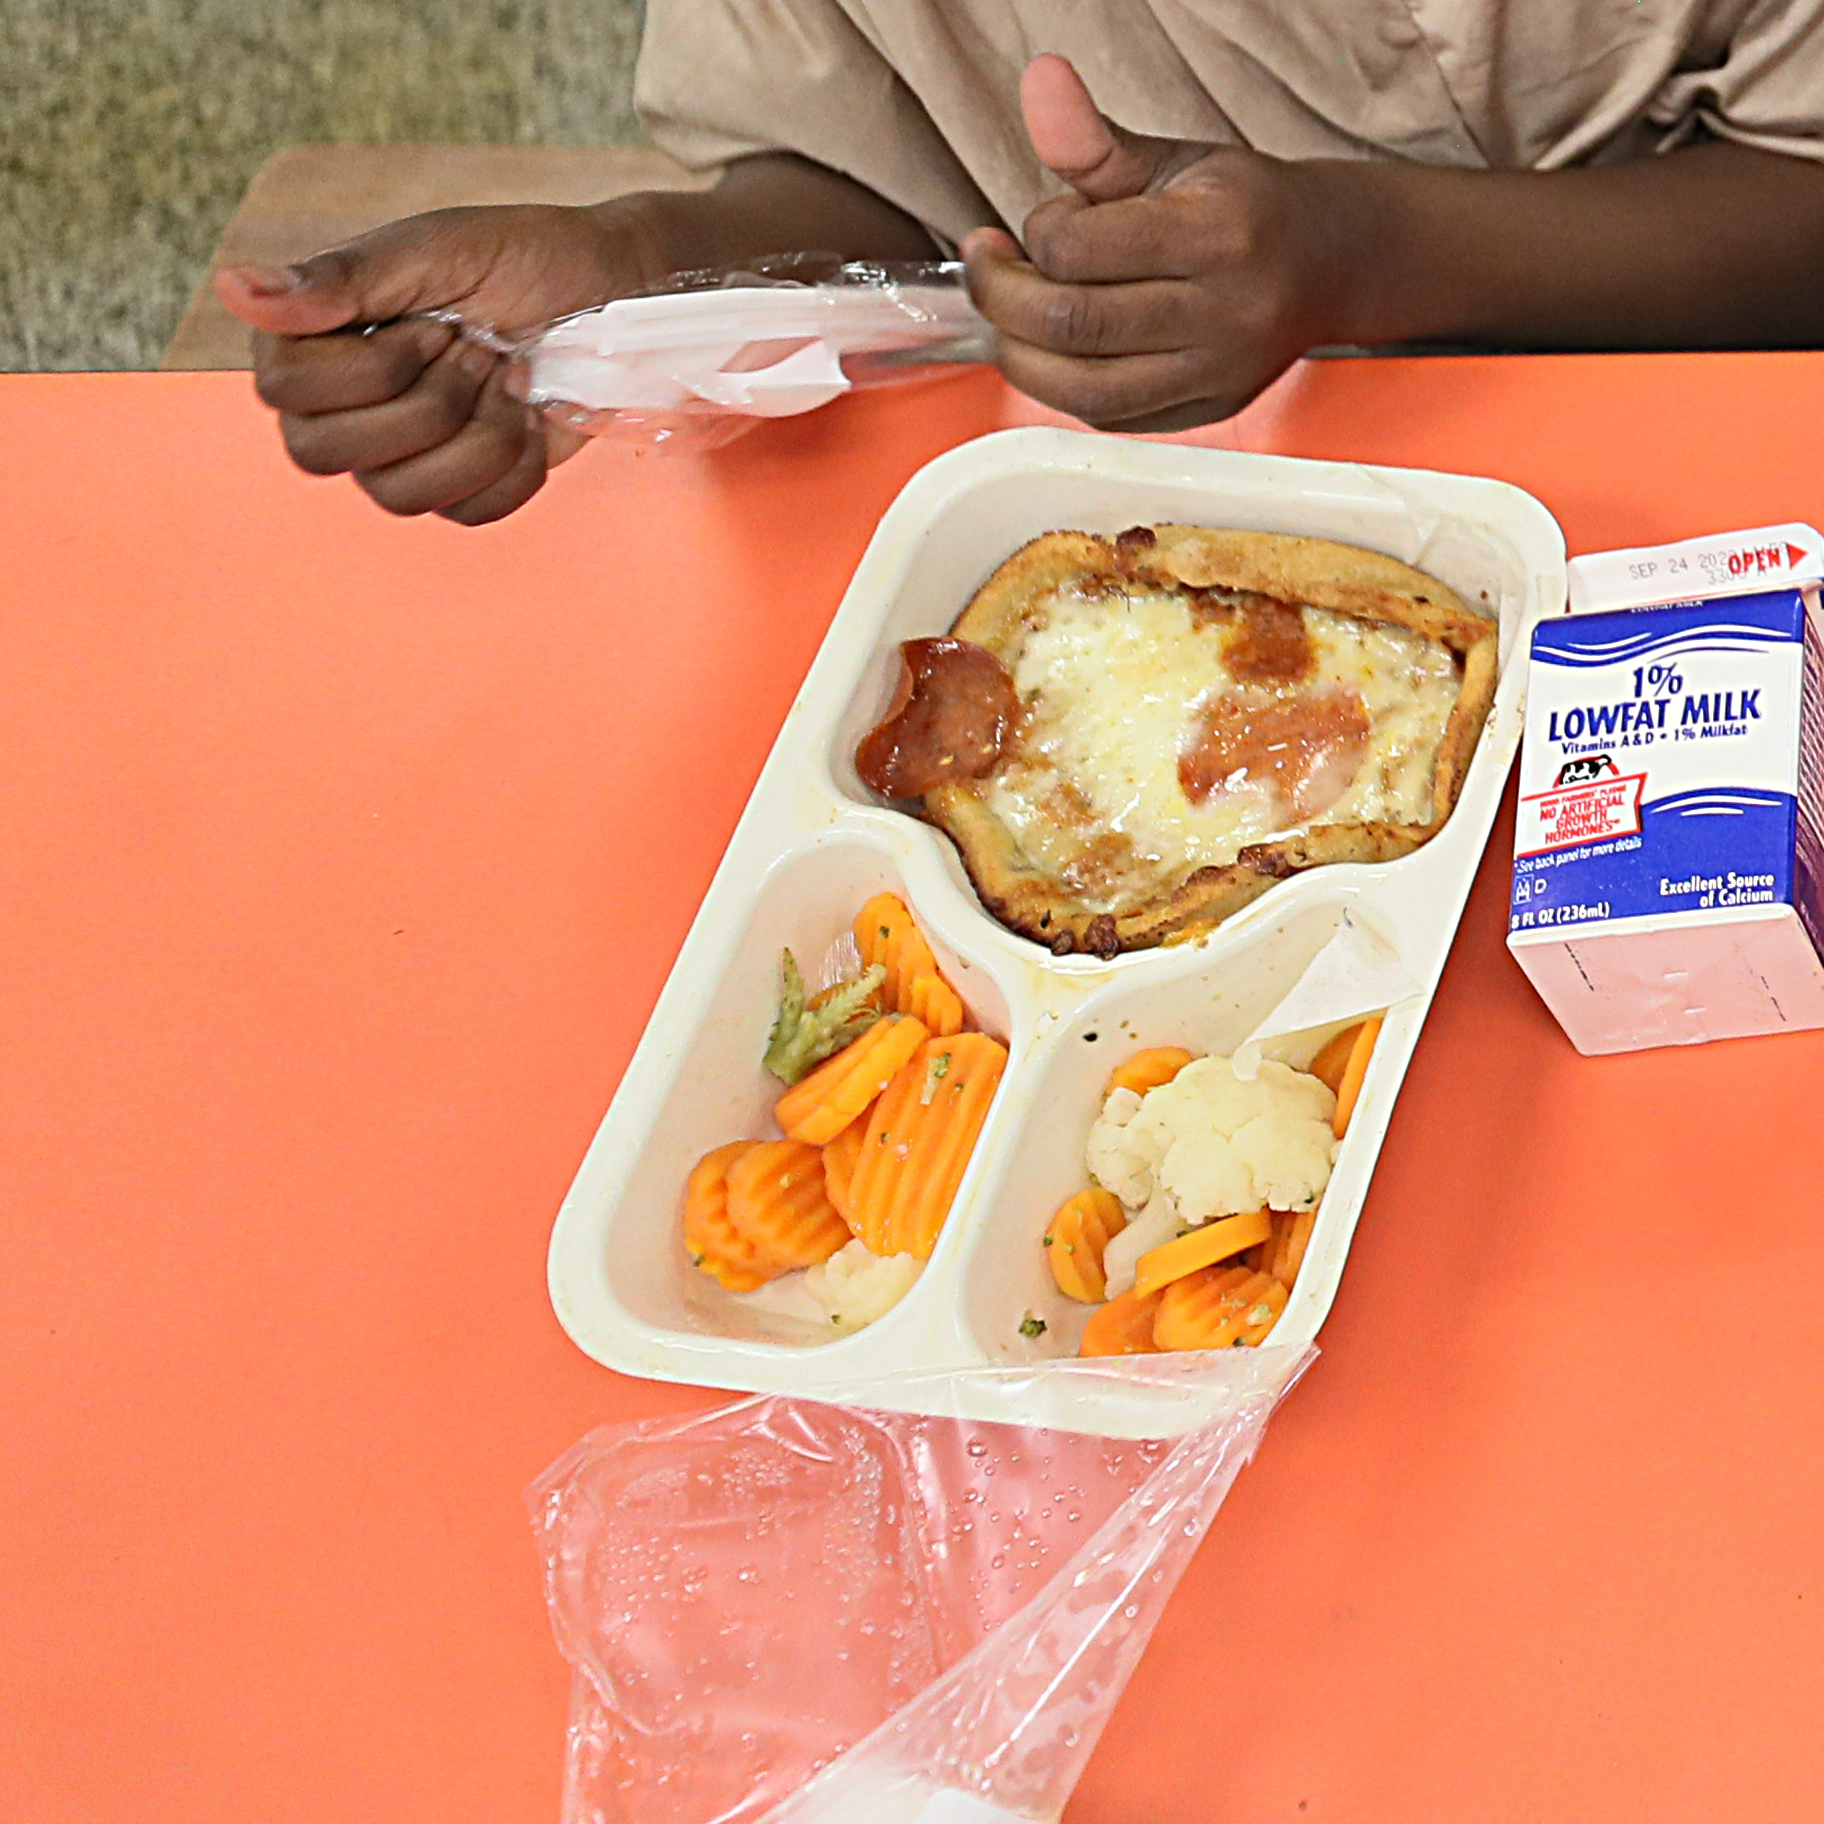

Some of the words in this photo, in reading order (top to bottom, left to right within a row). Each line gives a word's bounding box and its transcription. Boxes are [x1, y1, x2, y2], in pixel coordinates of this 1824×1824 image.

[1629, 563, 1658, 580] SEP
[1667, 557, 1688, 574] 24
[1728, 547, 1782, 575] OPEN
[1631, 660, 1685, 699] 1%
[1548, 697, 1671, 742] LOWFAT
[1680, 687, 1762, 727] MILK
[1561, 736, 1616, 755] Vitamins
[1673, 727, 1695, 742] 1%
[1700, 721, 1747, 739] Milkfat
[1540, 807, 1557, 822] NO
[1560, 794, 1626, 818] ARTIFICIAL
[1556, 809, 1608, 832] GROWTH
[1615, 836, 1643, 853] details
[1659, 873, 1722, 898] Excellent
[1727, 871, 1775, 890] Source
[1699, 889, 1715, 906] of
[1718, 882, 1774, 905] Calcium
[1511, 914, 1521, 930] 8
[1522, 912, 1535, 927] FL
[1538, 909, 1556, 925] OZ
[1557, 901, 1611, 923] (236mL)
